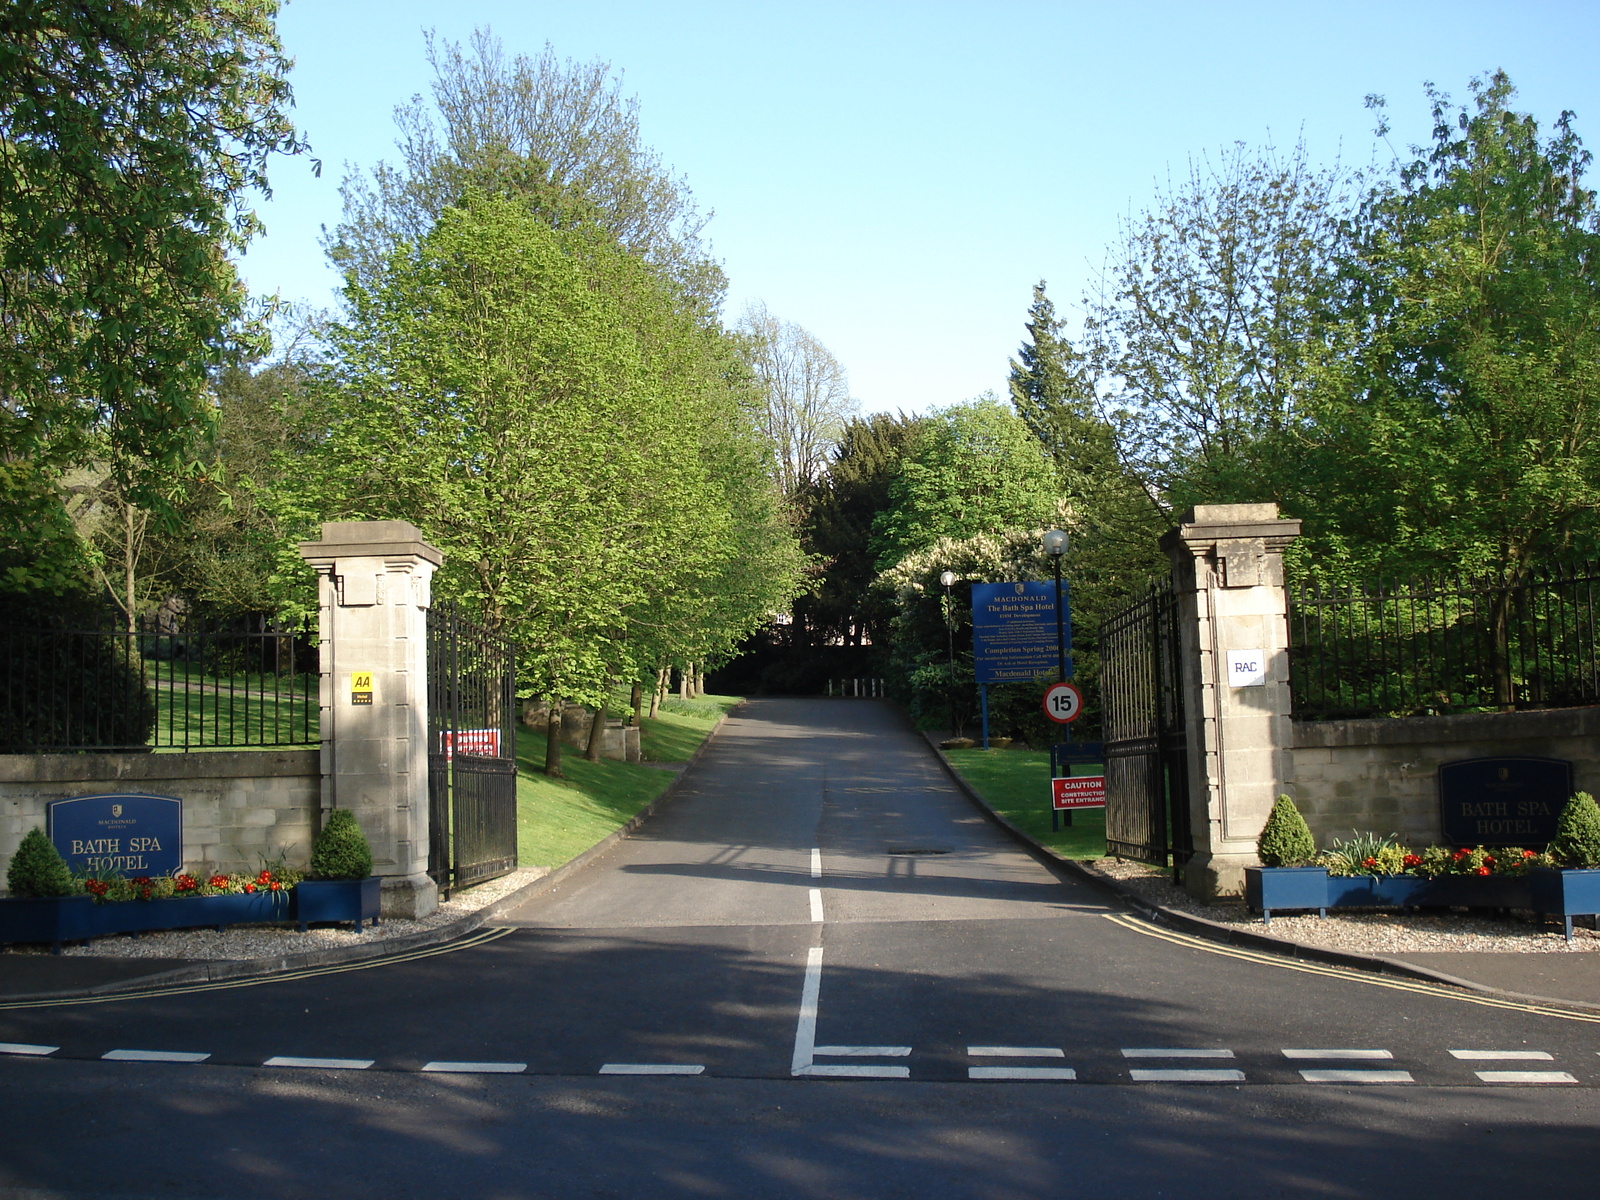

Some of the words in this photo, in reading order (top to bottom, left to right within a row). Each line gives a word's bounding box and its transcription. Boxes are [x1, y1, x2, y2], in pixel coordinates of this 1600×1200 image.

[994, 595, 1047, 603] MACDONALD
[1002, 604, 1019, 612] Bath
[1020, 603, 1034, 613] Spa
[1035, 603, 1054, 611] Hotel
[984, 646, 1022, 655] Completion
[1022, 646, 1044, 654] Spring
[1235, 662, 1257, 672] RAC
[995, 669, 1032, 678] Macdonald
[355, 676, 369, 687] AA
[1052, 695, 1071, 711] 15
[1064, 781, 1102, 790] CAUTION
[1461, 802, 1508, 817] BATH
[1517, 801, 1551, 816] SPA
[1476, 820, 1538, 835] HOTEL
[71, 838, 121, 855] BATH
[129, 837, 162, 853] SPA
[86, 855, 149, 872] HOTEL
